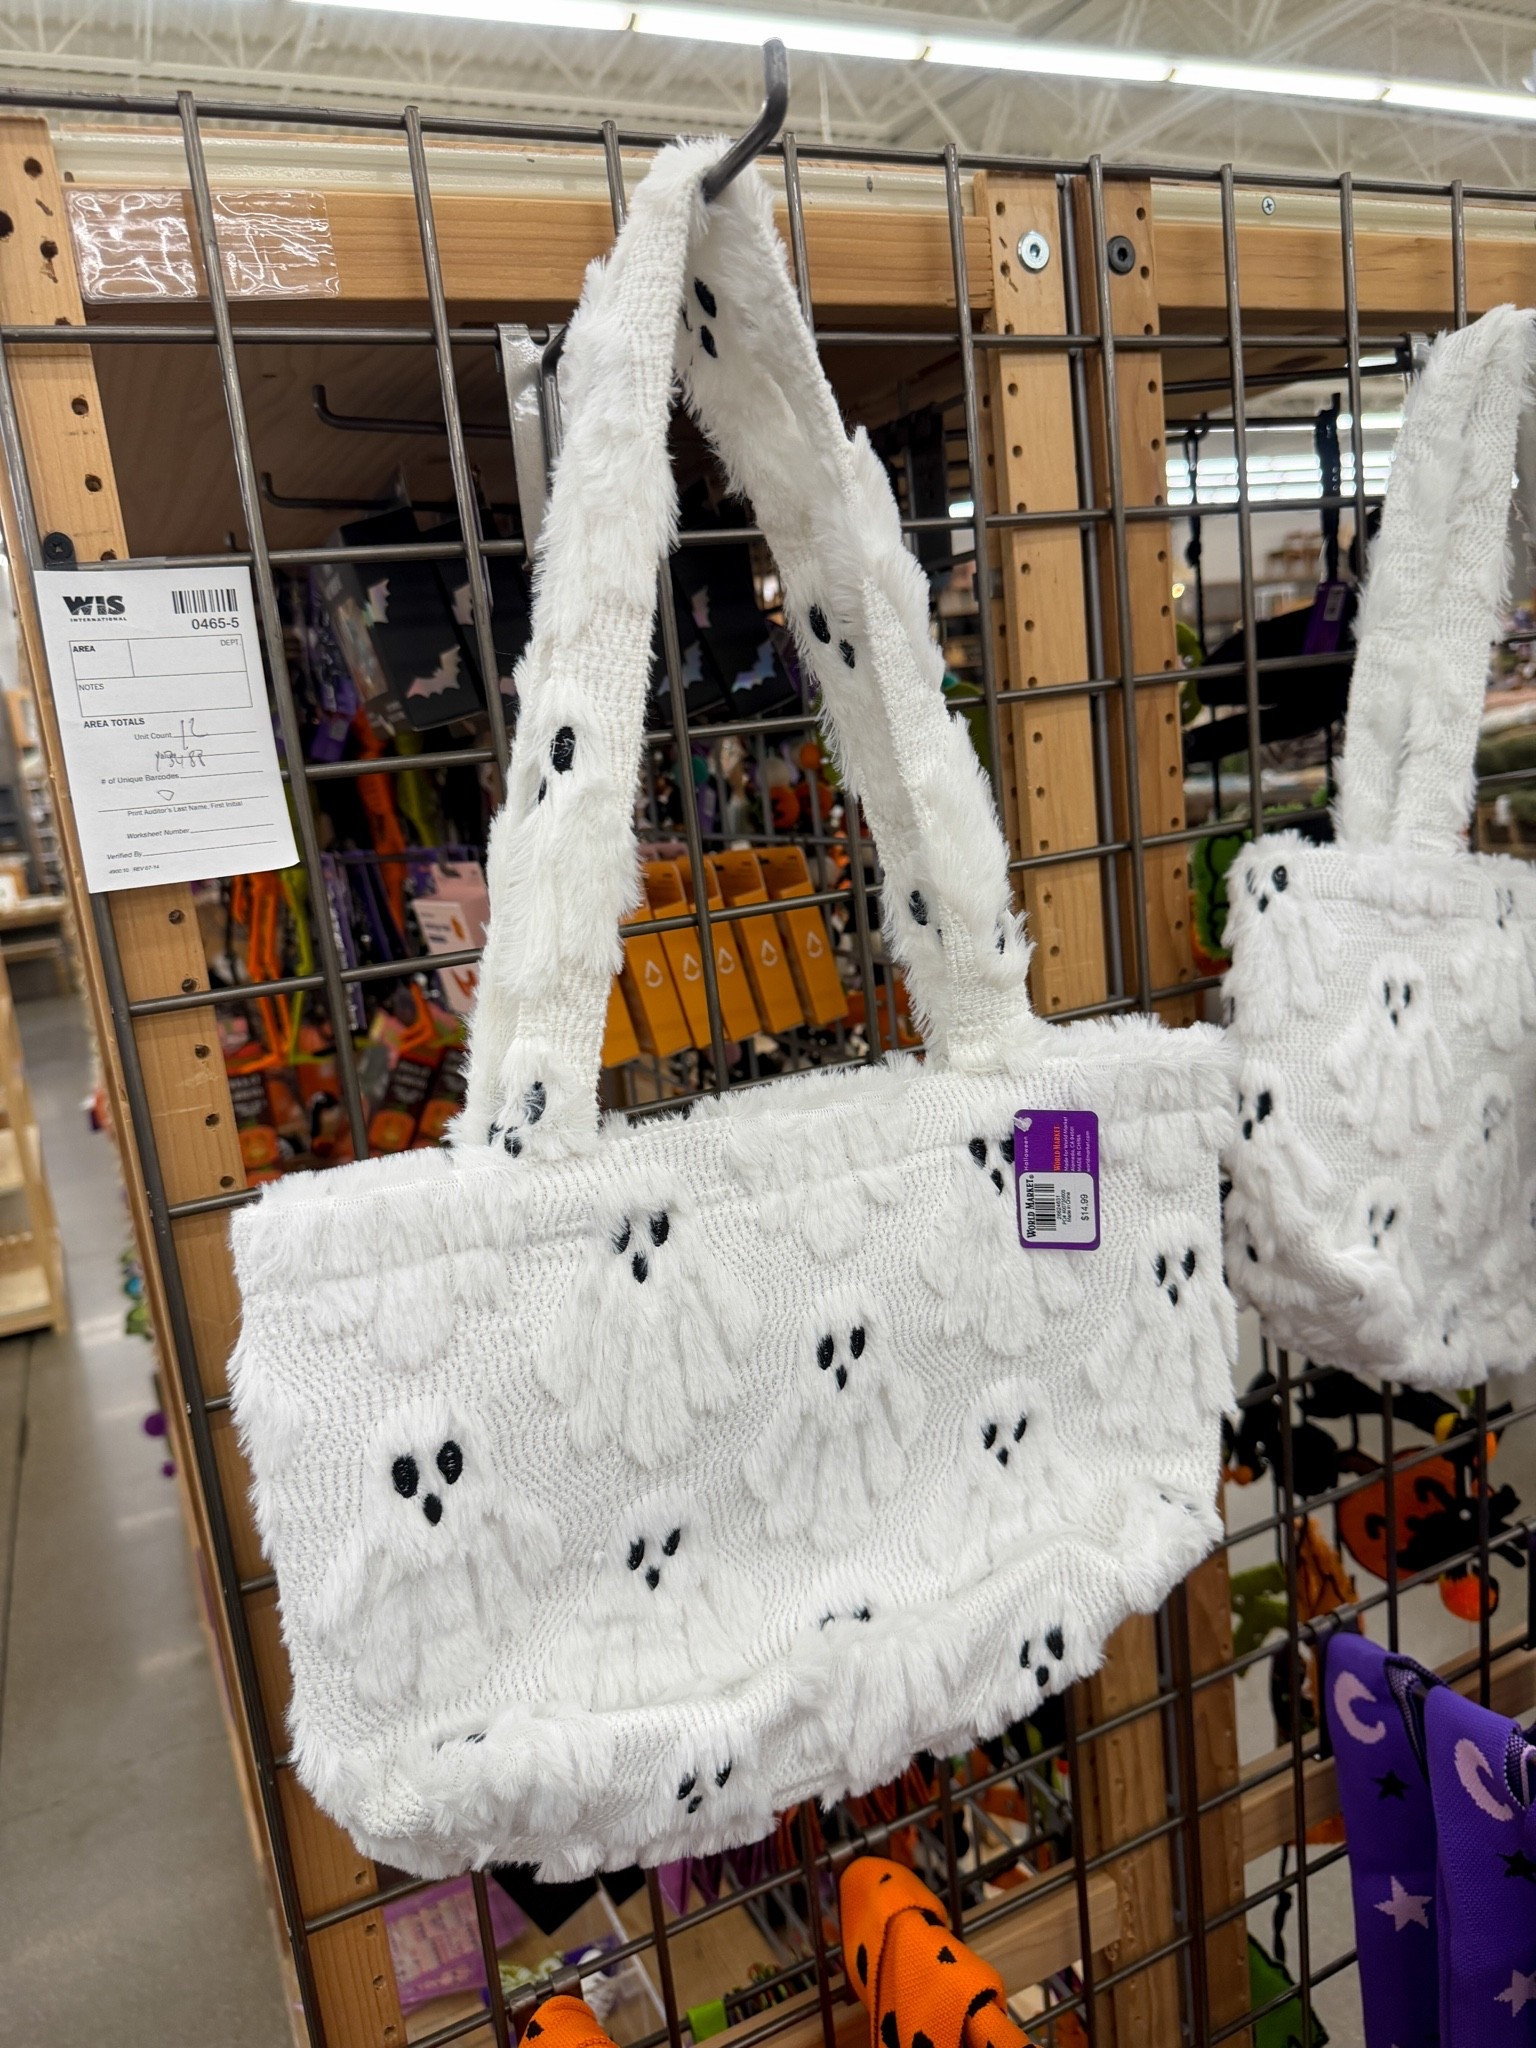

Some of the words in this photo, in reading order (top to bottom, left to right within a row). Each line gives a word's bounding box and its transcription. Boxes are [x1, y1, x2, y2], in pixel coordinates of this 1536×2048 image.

[62, 595, 126, 616] WIS
[191, 617, 239, 630] 0465-5
[72, 645, 96, 653] AREA
[220, 638, 242, 647] DEPT.
[78, 683, 105, 691] NOTES
[83, 720, 109, 729] AREA
[110, 717, 146, 727] TOTALS
[134, 733, 149, 741] Unit
[150, 732, 172, 740] Count
[108, 777, 116, 785] of
[117, 775, 143, 786] Unique
[145, 772, 180, 782] Barcodes
[127, 809, 143, 817] Print
[144, 806, 172, 815] Auditor's
[173, 805, 187, 813] Last
[188, 803, 210, 812] Name,
[225, 800, 243, 808] Initial
[126, 829, 162, 840] Worksheet
[163, 827, 190, 836] Number
[106, 851, 132, 860] Verified
[133, 851, 142, 859] By
[1052, 1126, 1061, 1150] MARKET
[1053, 1150, 1061, 1171] WORLD
[1079, 1193, 1090, 1221] $14.99
[1026, 1211, 1036, 1238] WORLD
